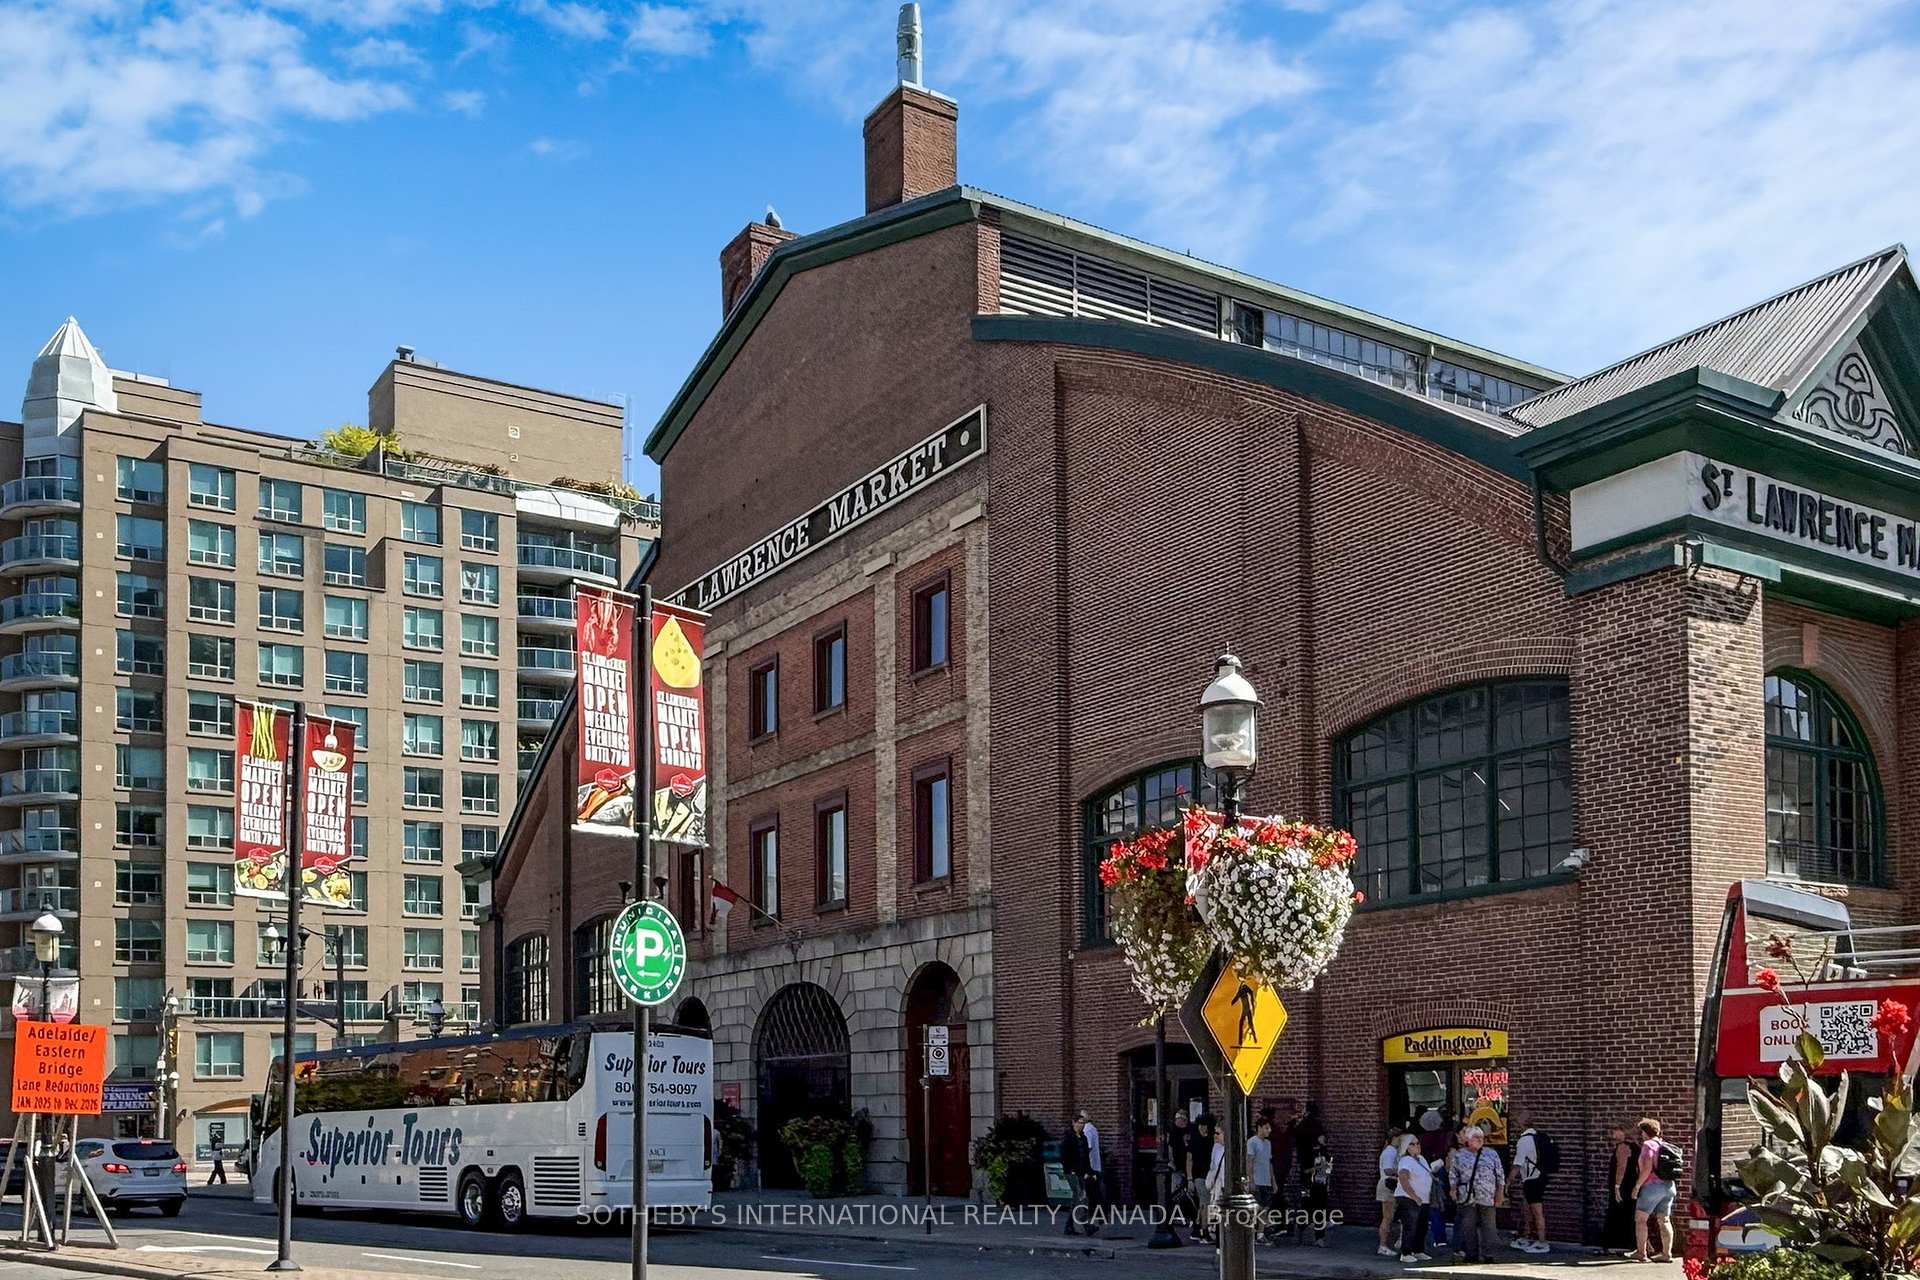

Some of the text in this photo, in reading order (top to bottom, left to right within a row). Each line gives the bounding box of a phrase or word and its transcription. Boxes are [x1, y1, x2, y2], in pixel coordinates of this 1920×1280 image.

[698, 518, 808, 608] LAWRENCE
[828, 434, 947, 533] MARKET
[1747, 476, 1888, 560] LAWRENCE
[1897, 523, 1920, 572] M
[582, 663, 627, 692] MARKET
[583, 683, 628, 716] OPEN
[584, 709, 629, 734] WEEKDAY
[657, 703, 699, 729] MARKET
[585, 727, 629, 751] EVENINGS
[658, 722, 701, 754] OPEN
[241, 765, 282, 787] MARKET
[308, 776, 347, 798] MARKET
[241, 780, 282, 808] OPEN
[307, 792, 347, 818] OPEN
[240, 801, 281, 821] WEEKDAY
[307, 812, 346, 831] WEEKDAY
[614, 907, 681, 952] MUNICIPAL
[636, 928, 664, 967] P
[615, 959, 681, 999] PARKING
[28, 1027, 96, 1043] Adelaide/
[1404, 1031, 1492, 1056] Paddington's
[35, 1044, 85, 1059] Eastern
[38, 1062, 84, 1077] Bridge
[604, 1053, 706, 1077] Supior Tours
[17, 1079, 100, 1093] Lane Reductions
[306, 1112, 463, 1178] Superior Tours
